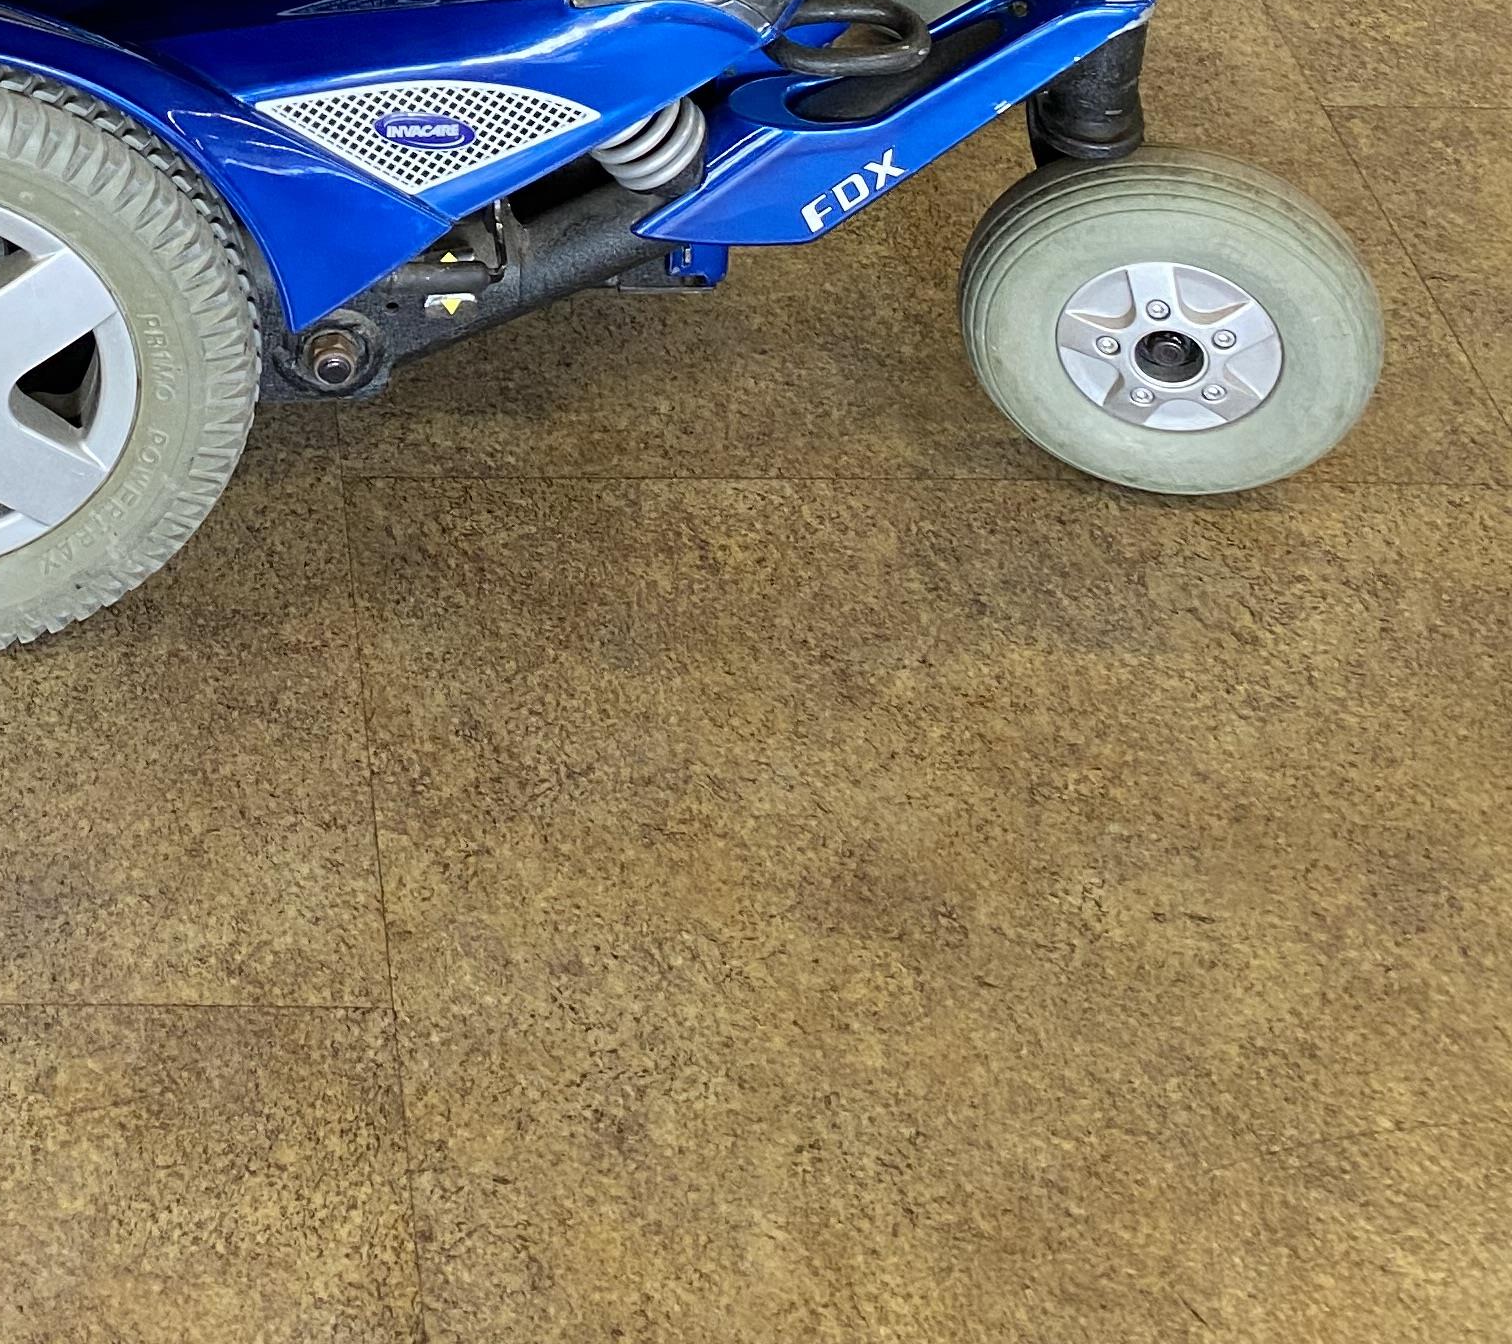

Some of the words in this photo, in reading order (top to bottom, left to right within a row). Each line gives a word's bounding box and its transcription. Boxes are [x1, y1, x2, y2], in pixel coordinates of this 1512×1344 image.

[386, 121, 460, 143] INVACARE
[800, 148, 908, 232] FDX
[135, 313, 176, 401] PRIMO
[40, 428, 168, 576] POWERTRAX
